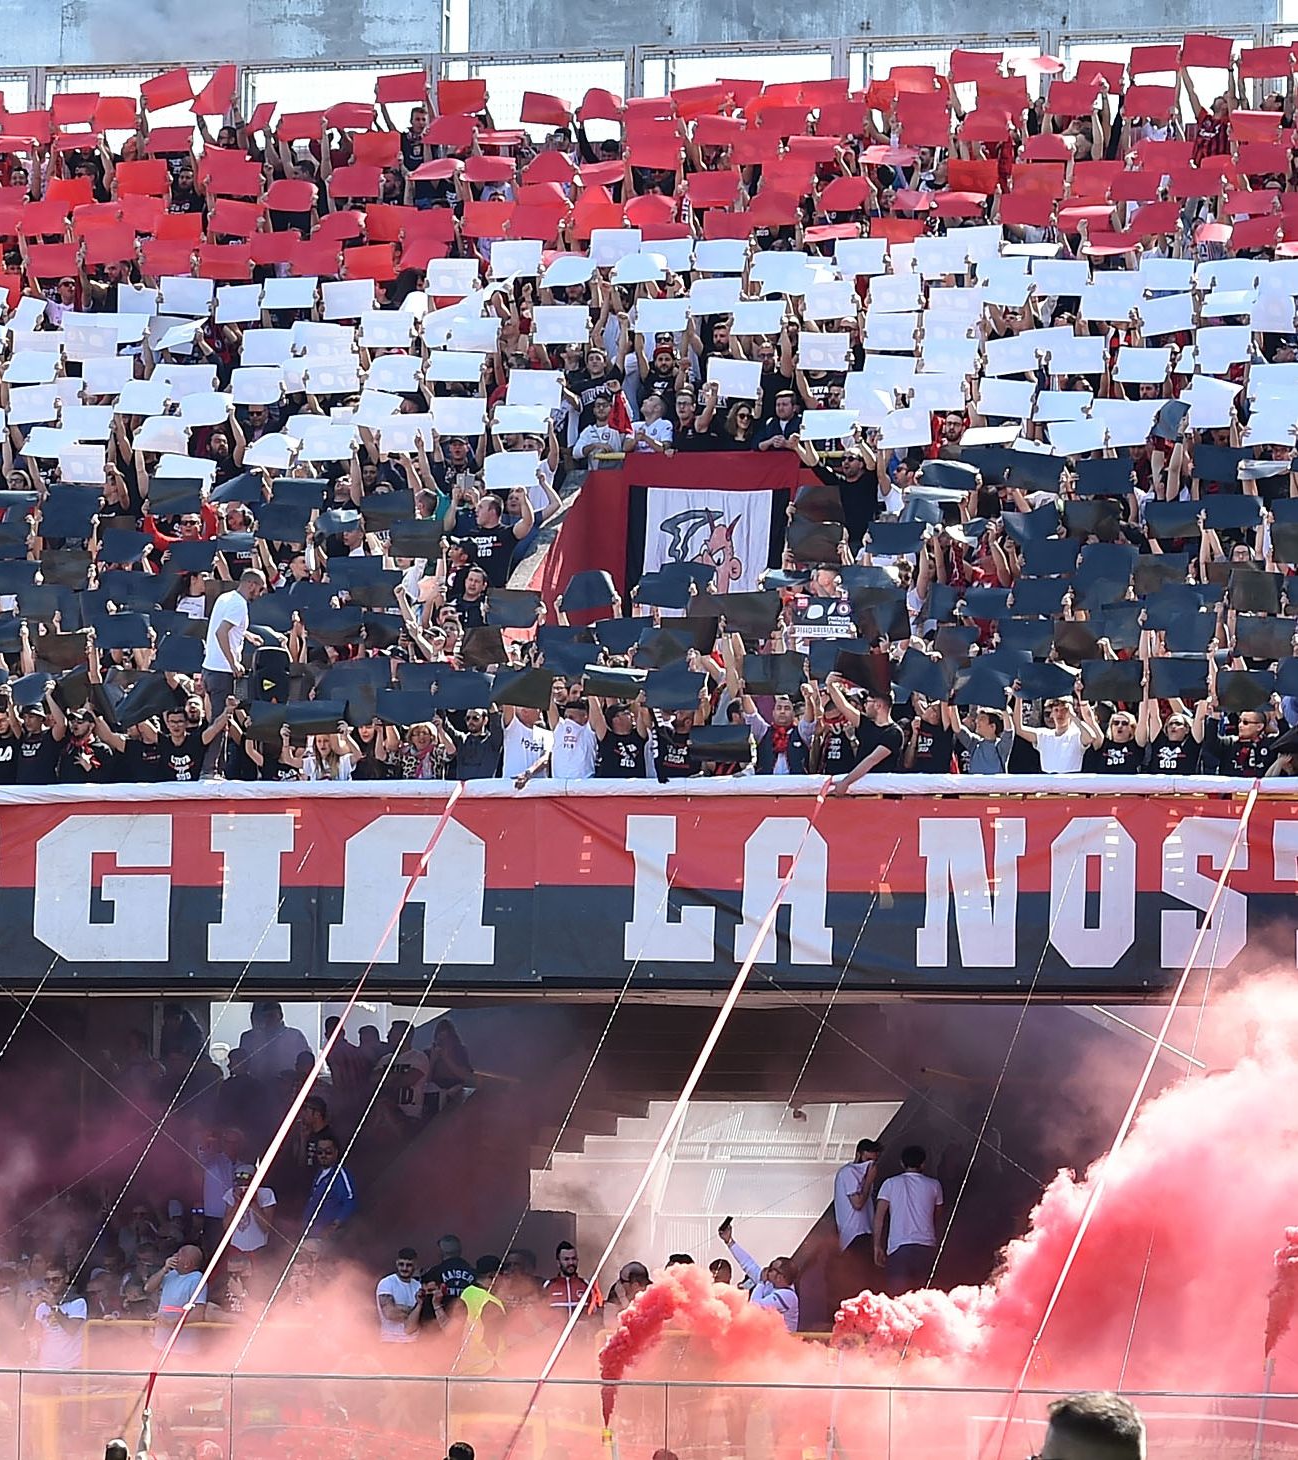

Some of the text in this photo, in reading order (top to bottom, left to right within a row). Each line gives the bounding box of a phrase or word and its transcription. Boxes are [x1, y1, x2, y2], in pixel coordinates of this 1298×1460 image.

[624, 815, 834, 965] LA
[916, 816, 1298, 969] NOS
[442, 1269, 474, 1284] KAISER
